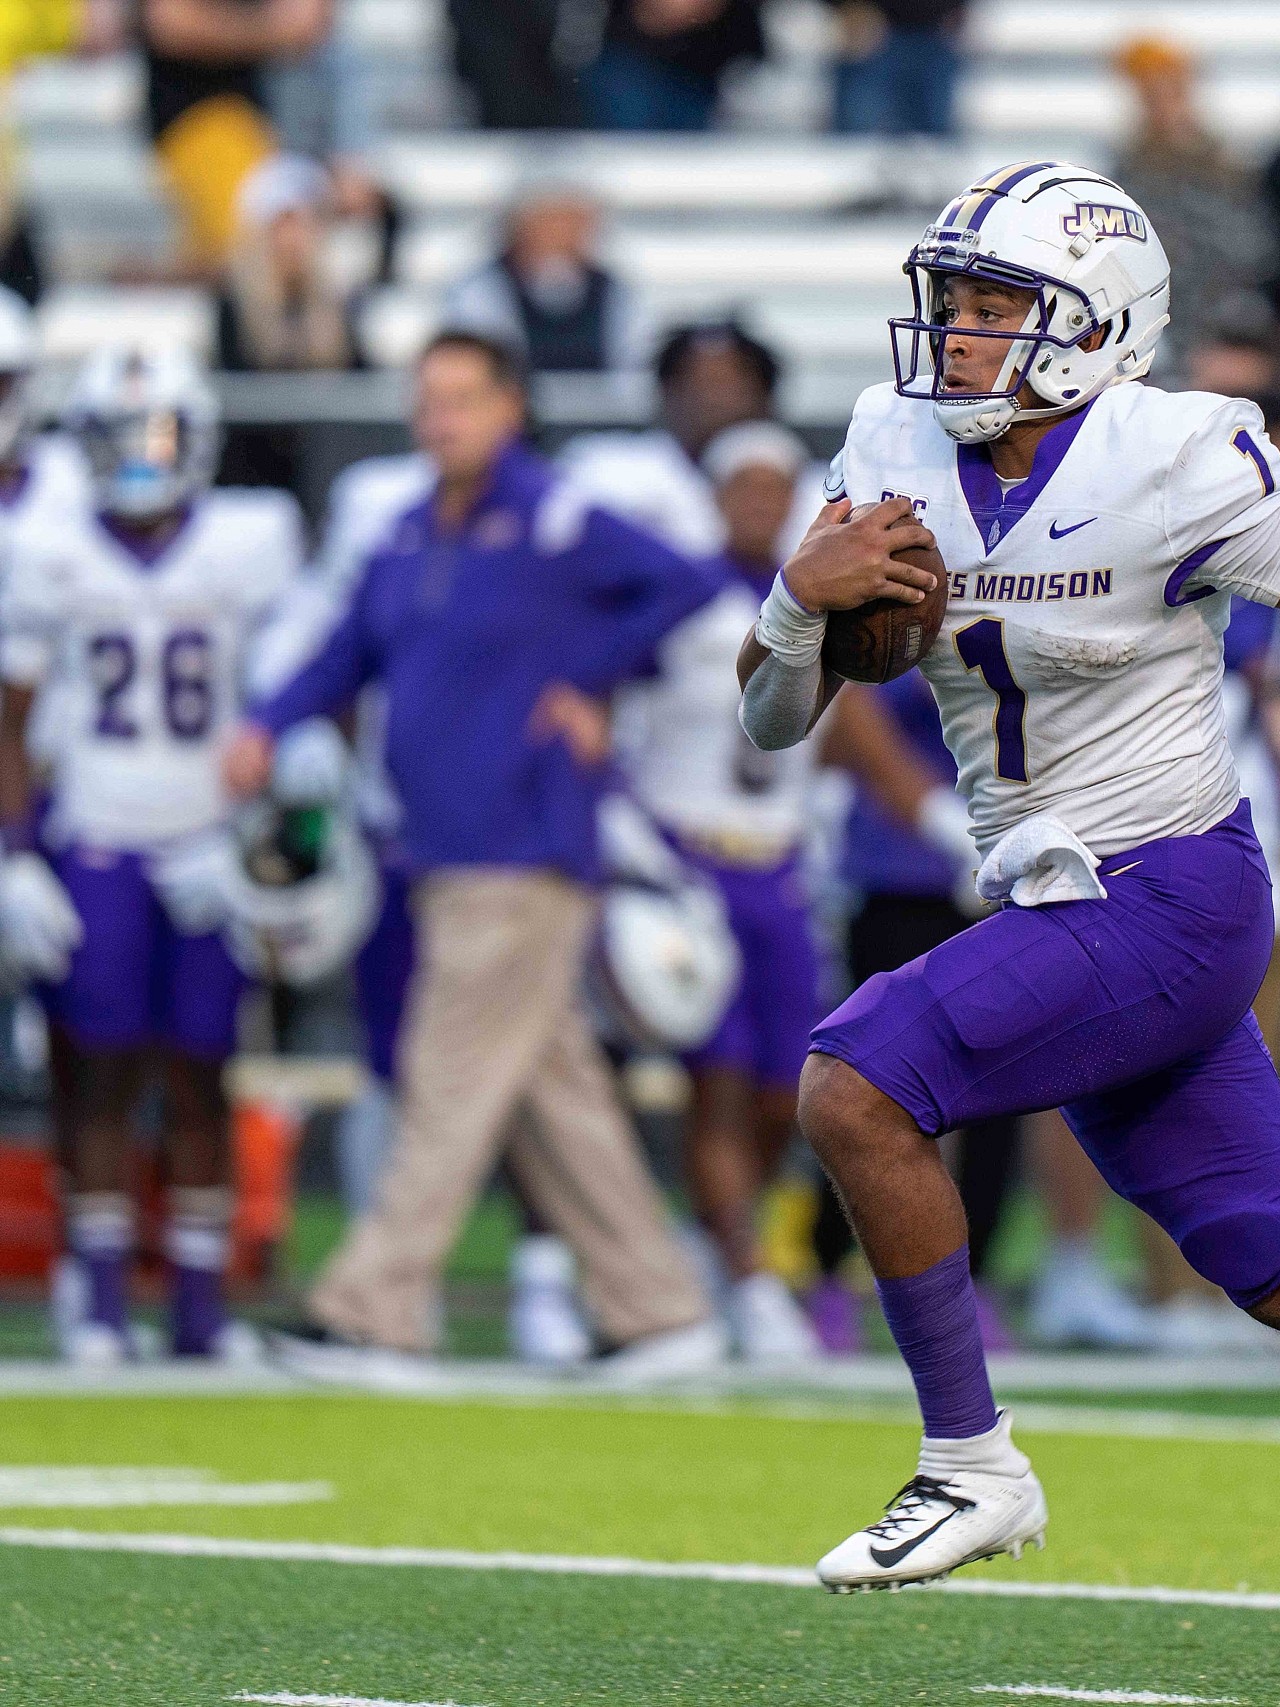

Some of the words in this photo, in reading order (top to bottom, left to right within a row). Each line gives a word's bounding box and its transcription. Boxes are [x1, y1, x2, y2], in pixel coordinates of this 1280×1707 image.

[1062, 203, 1147, 242] JMU
[1229, 425, 1276, 498] 1
[973, 567, 1113, 603] MADISON
[86, 627, 215, 744] 26
[951, 615, 1032, 787] 1
